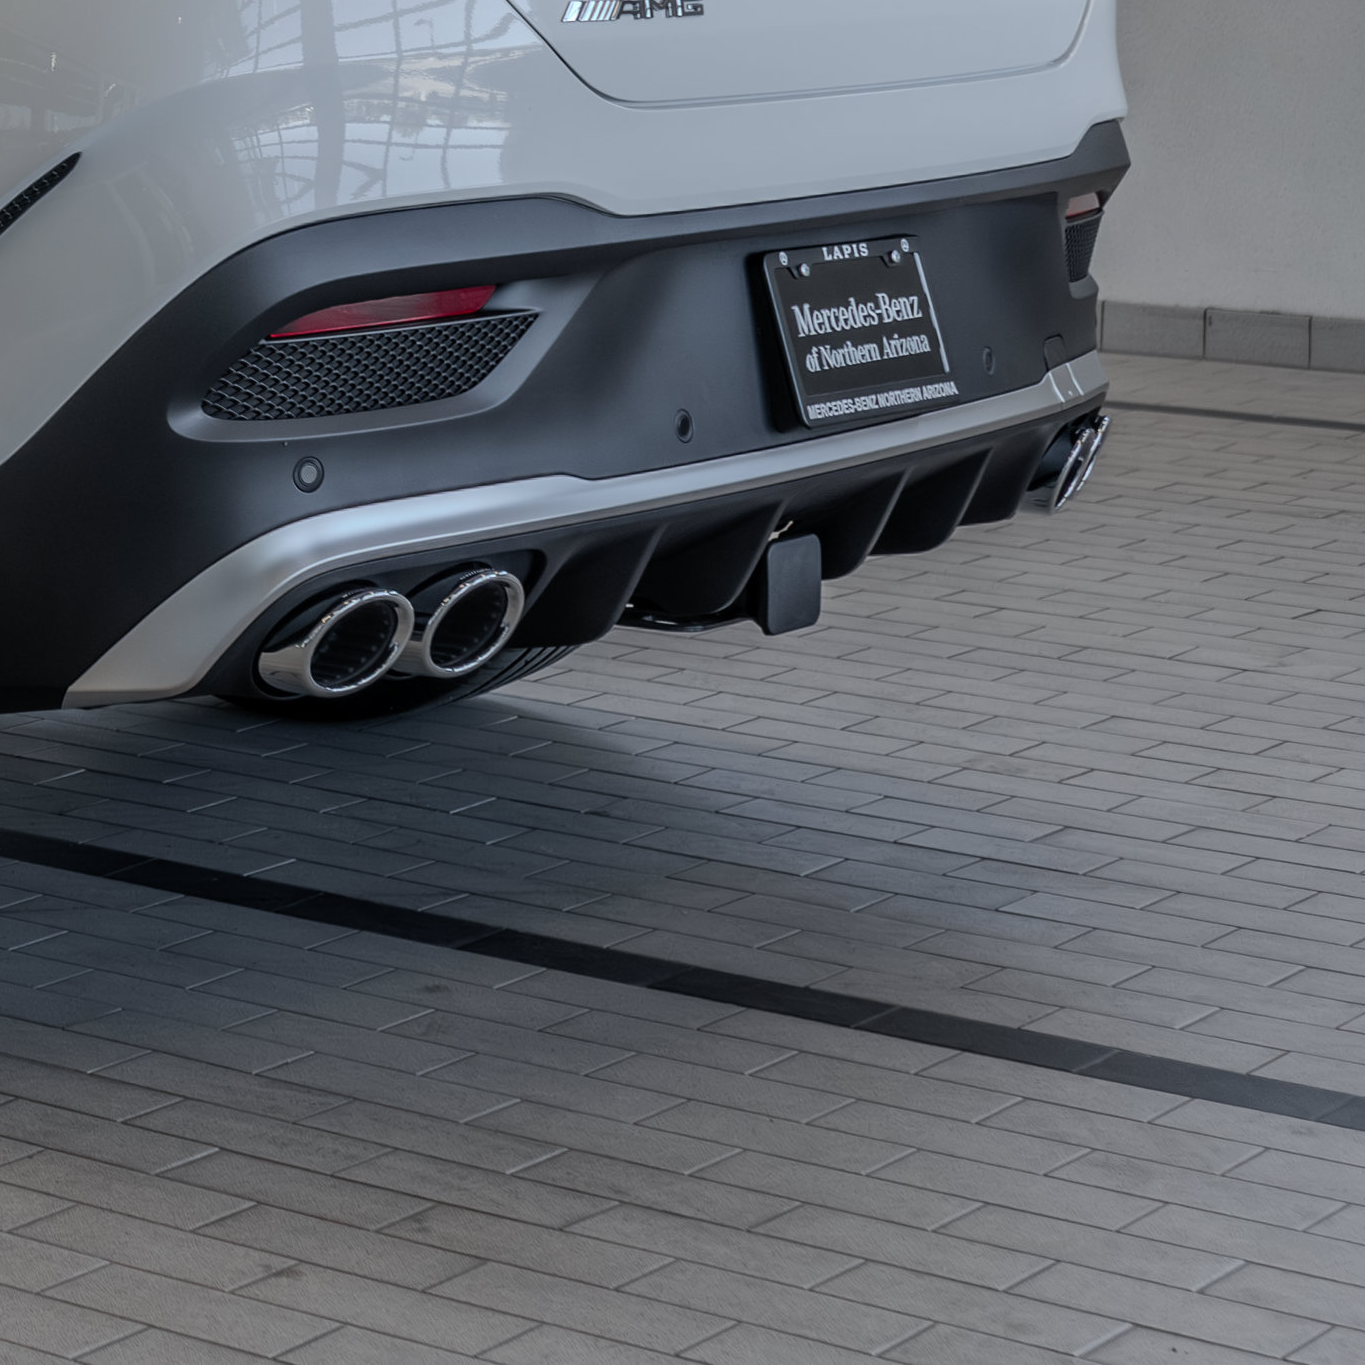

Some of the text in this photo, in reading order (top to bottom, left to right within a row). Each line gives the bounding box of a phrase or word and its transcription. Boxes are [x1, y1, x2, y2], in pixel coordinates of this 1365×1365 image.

[822, 243, 869, 261] LAPIS
[791, 292, 923, 337] Mercedes-Benz
[805, 333, 931, 373] of Northern Arizona
[807, 381, 959, 420] MERCEDES-BENZ NORTHERN ARIZONA
